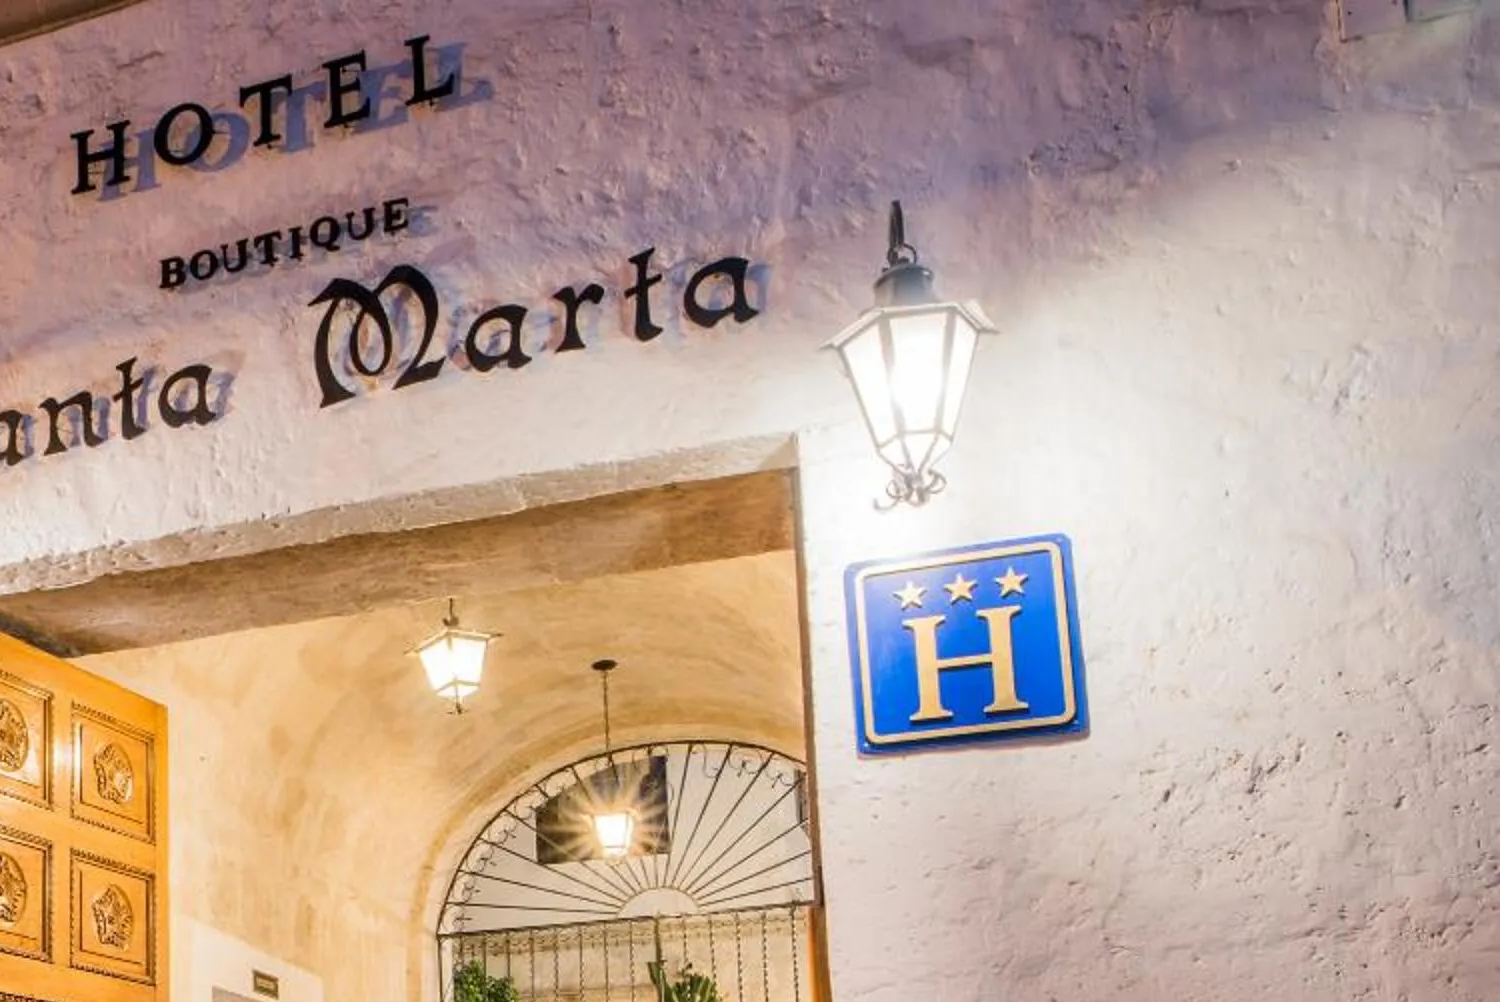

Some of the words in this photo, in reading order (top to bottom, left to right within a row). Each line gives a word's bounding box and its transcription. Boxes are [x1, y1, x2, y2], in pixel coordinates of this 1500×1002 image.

[70, 34, 455, 195] HOTEL
[158, 197, 411, 290] BOUTIQUE
[298, 246, 760, 409] Marta
[902, 604, 1030, 723] H
